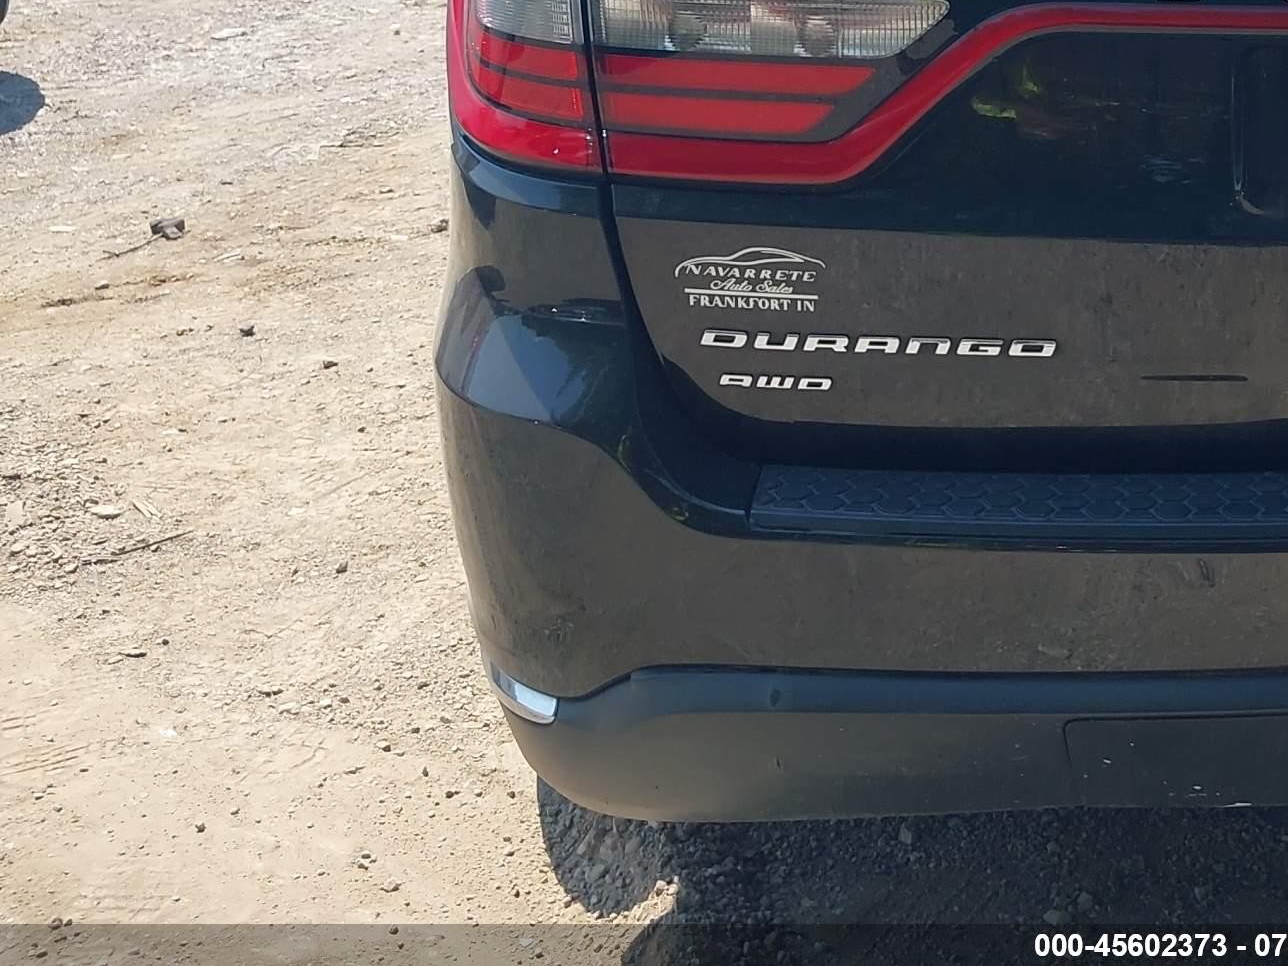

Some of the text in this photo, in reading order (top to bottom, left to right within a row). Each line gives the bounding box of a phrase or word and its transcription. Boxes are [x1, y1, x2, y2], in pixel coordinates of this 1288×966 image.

[685, 264, 817, 282] NAVARRETE
[709, 278, 793, 294] Auto Sales
[689, 294, 815, 312] FRANKFORT IN
[700, 329, 1057, 358] DURANGO
[719, 374, 832, 391] AWD
